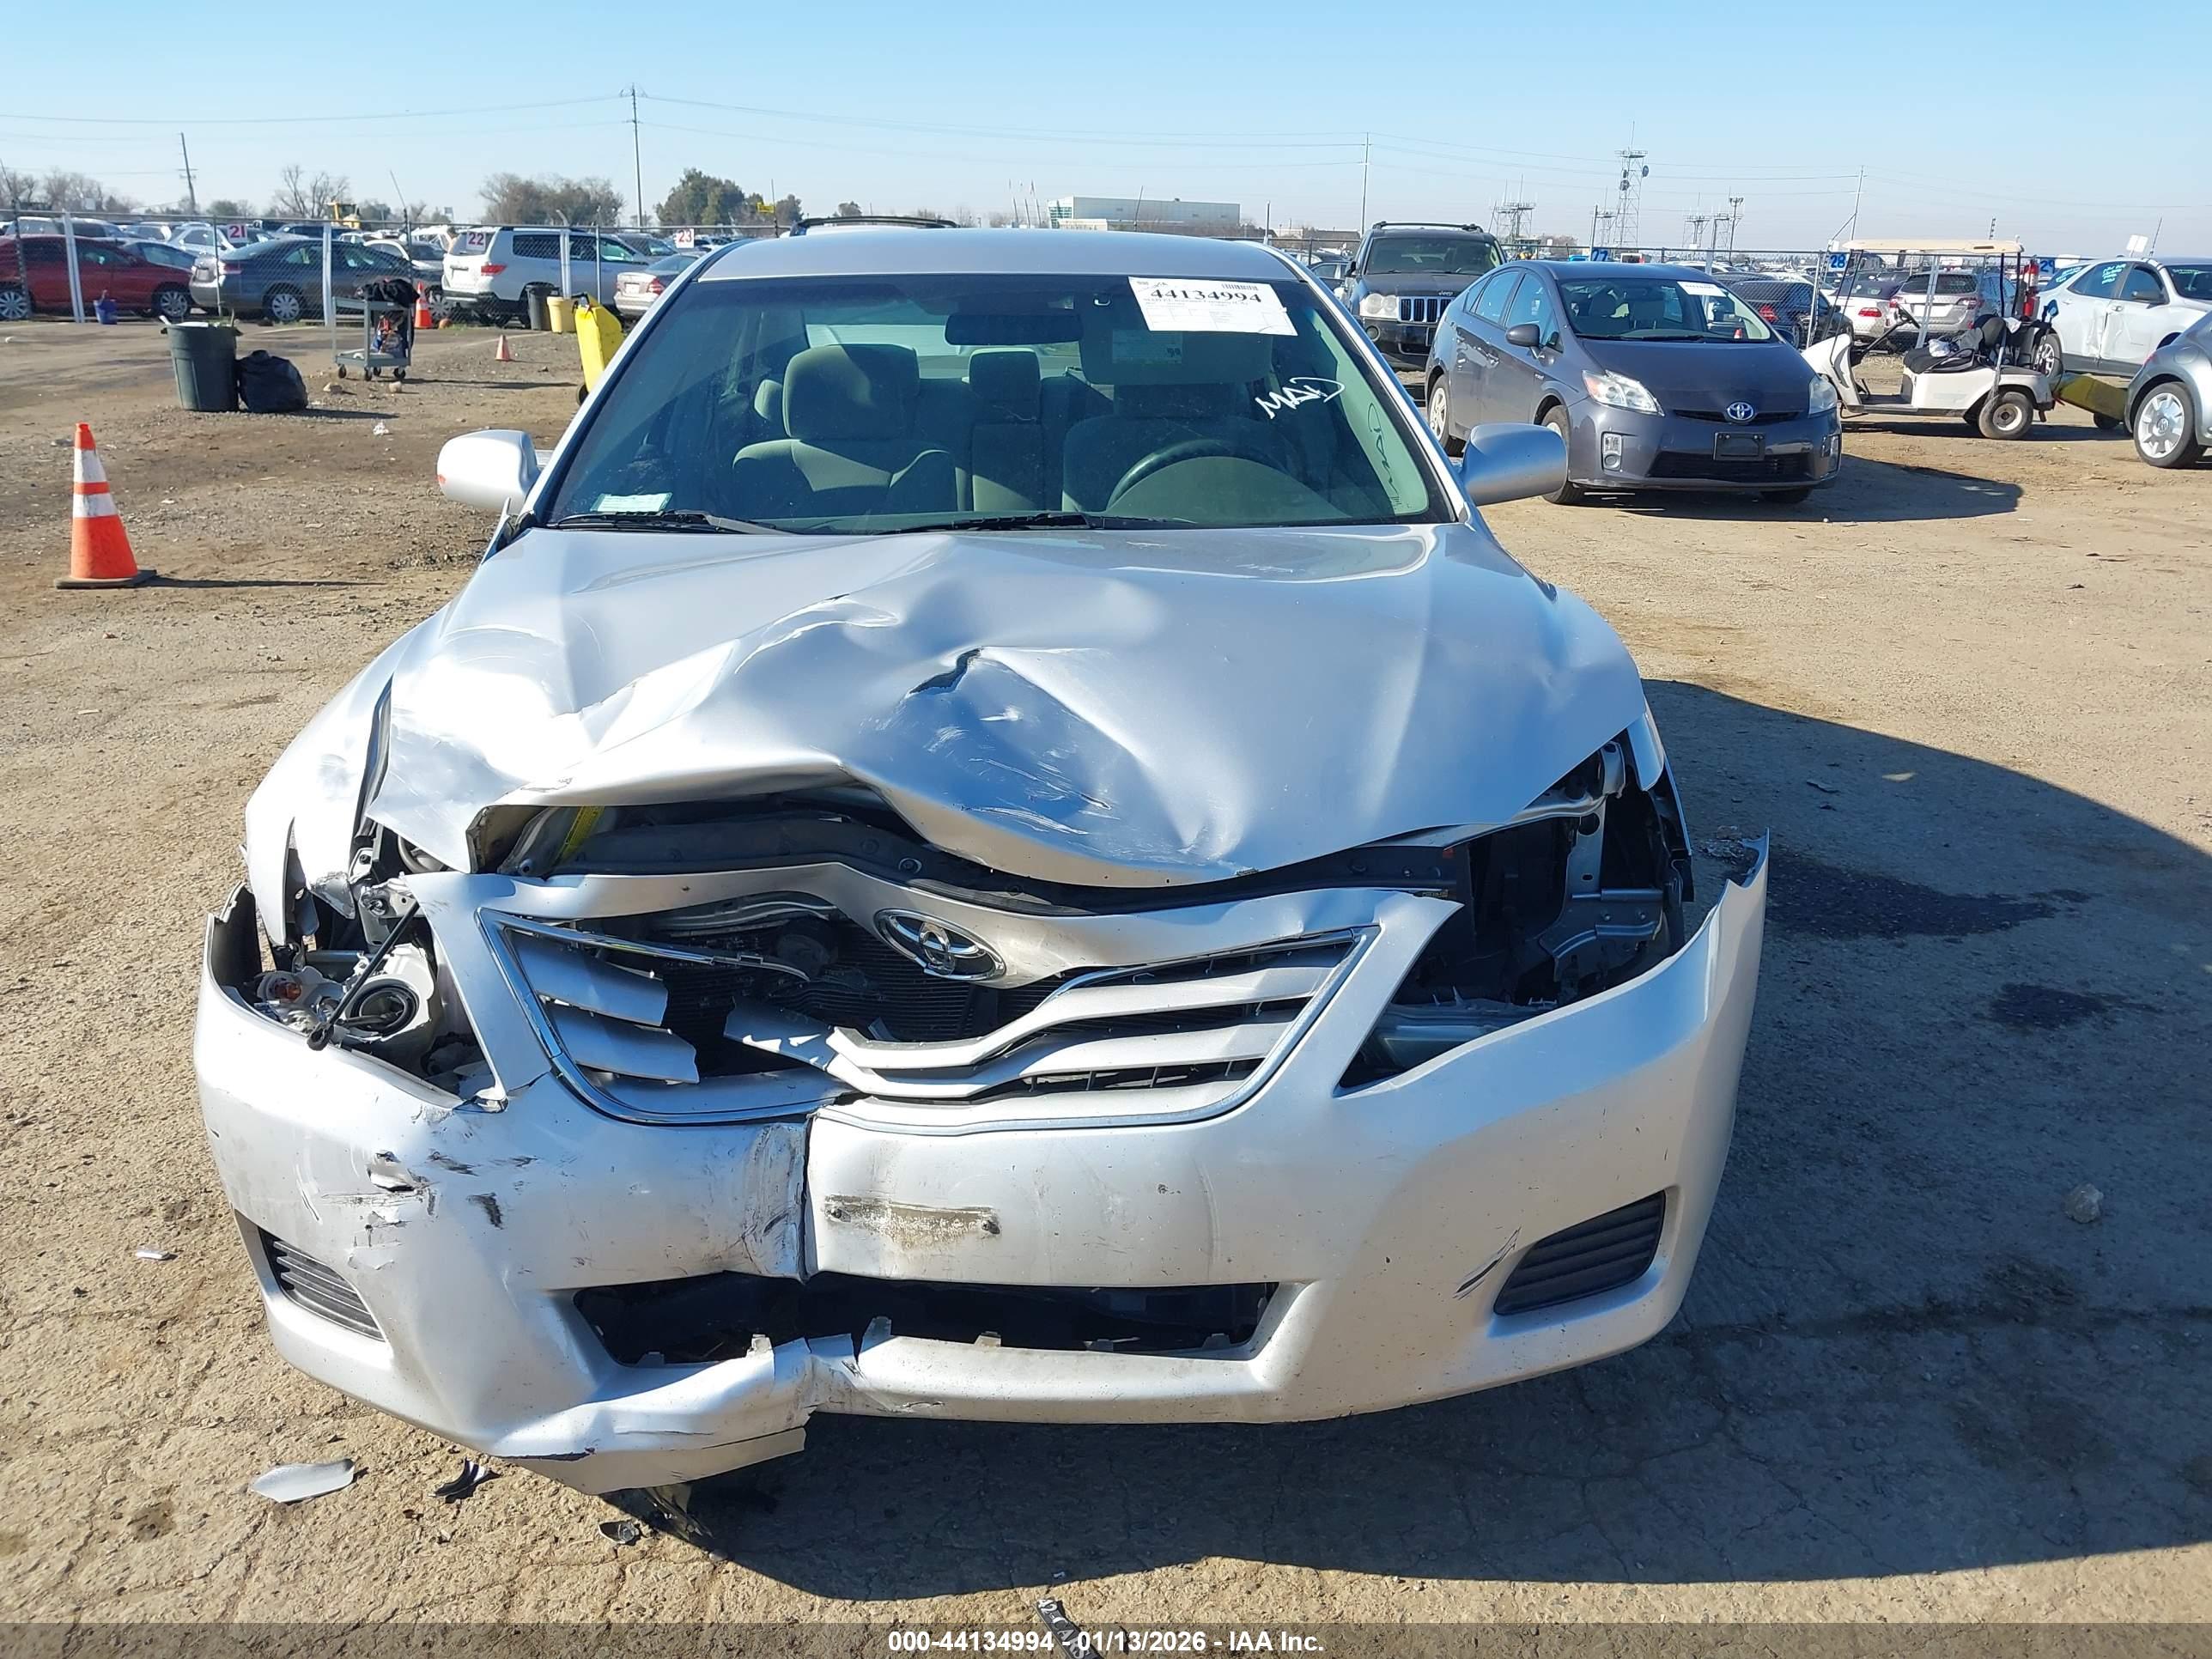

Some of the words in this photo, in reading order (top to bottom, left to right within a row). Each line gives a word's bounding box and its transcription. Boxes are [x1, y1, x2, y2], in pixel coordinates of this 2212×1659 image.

[229, 225, 246, 238] 21
[678, 228, 692, 242] 23
[468, 232, 484, 246] 22
[1831, 253, 1845, 268] 28
[1151, 289, 1261, 302] 44134994
